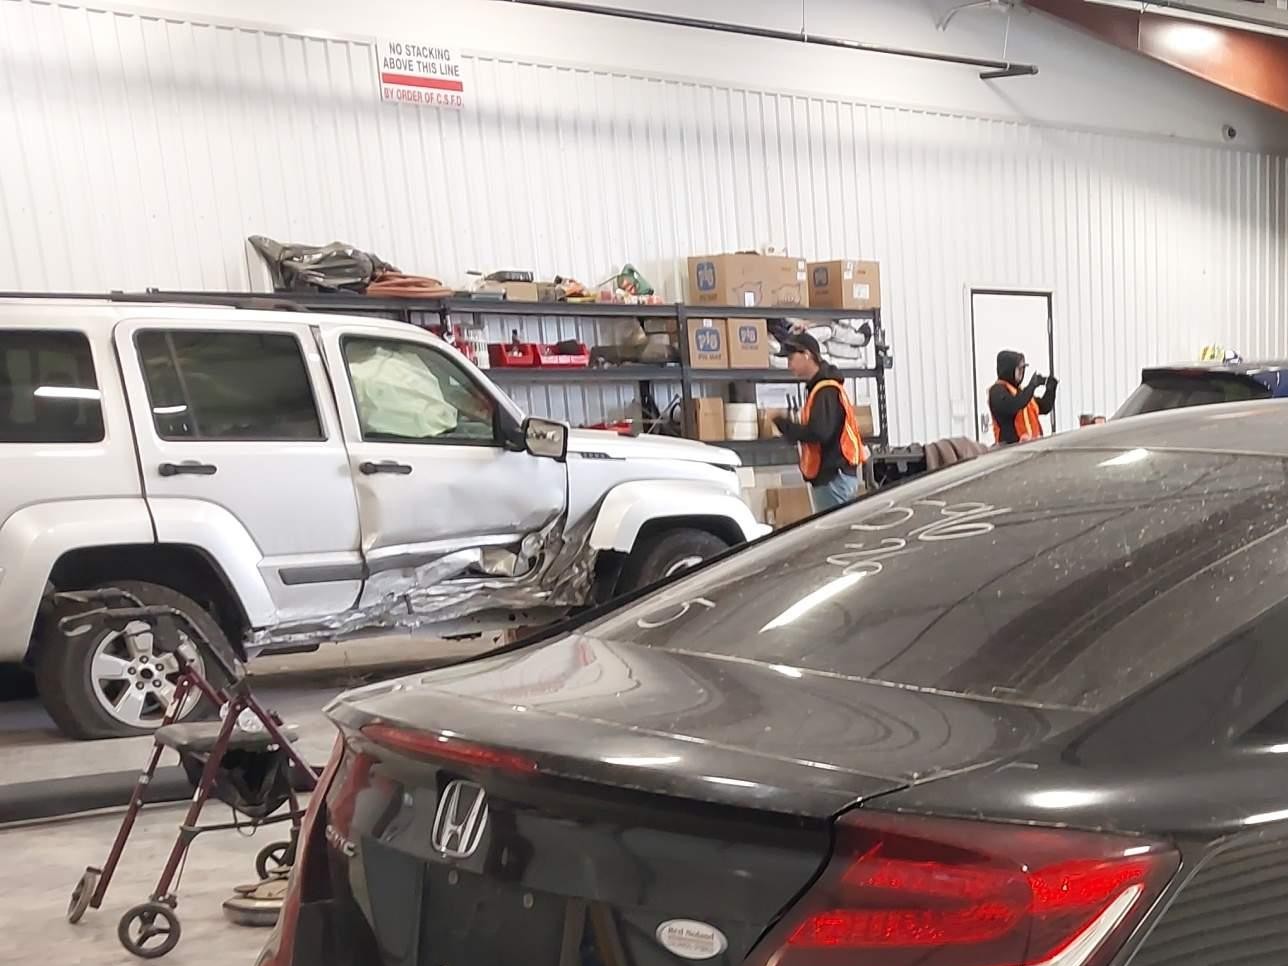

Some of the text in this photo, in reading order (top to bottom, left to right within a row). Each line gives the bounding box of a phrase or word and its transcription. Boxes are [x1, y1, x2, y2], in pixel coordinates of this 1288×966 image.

[389, 42, 450, 61] NO STACKING
[383, 57, 460, 77] ABOVE THIS LINE
[384, 87, 394, 99] BY
[396, 89, 422, 102] ORDER
[425, 91, 435, 104] OF
